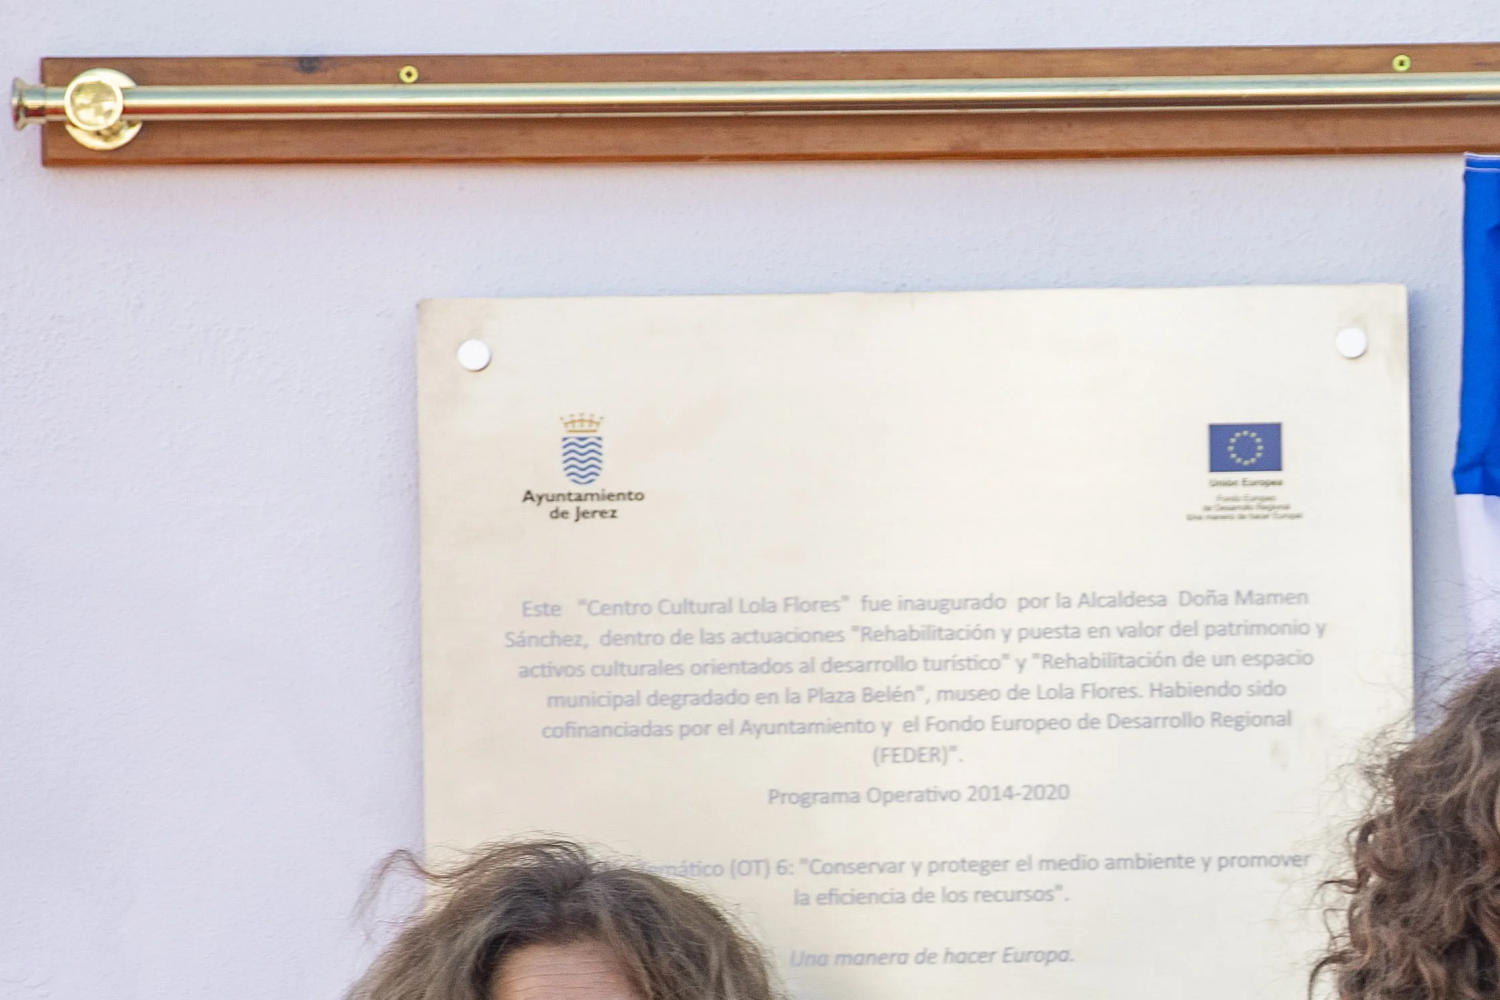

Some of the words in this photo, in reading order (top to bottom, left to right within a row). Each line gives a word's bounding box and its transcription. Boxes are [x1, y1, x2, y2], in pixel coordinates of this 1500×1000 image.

[522, 489, 646, 506] Ayuntamiento
[549, 507, 570, 519] de
[574, 506, 618, 522] Jerez
[521, 600, 562, 618] Este
[577, 598, 653, 617] "Centro
[657, 596, 734, 616] Cultural
[738, 596, 778, 615] Lola
[782, 594, 850, 614] Flores"
[860, 594, 893, 613] fue
[897, 592, 1008, 616] inaugurado
[1017, 596, 1051, 614] por
[1055, 591, 1073, 610] la
[1076, 590, 1169, 609] Alcaldesa
[1178, 588, 1230, 608] Doña
[1234, 588, 1309, 607] Mamen
[504, 629, 589, 650] Sánchez,
[599, 629, 666, 647] dentro
[669, 627, 696, 646] de
[699, 627, 726, 646] las
[730, 626, 846, 645] actuaciones
[850, 623, 997, 643] "Rehabilitación
[1000, 627, 1013, 645] y
[1016, 623, 1082, 644] puesta
[1086, 625, 1112, 640] en
[1115, 620, 1165, 639] valor
[1168, 619, 1199, 638] del
[1203, 618, 1312, 641] patrimonio
[1315, 622, 1328, 639] y
[518, 660, 586, 679] activos
[590, 658, 686, 678] culturales
[689, 656, 795, 676] orientados
[798, 655, 816, 675] al
[819, 654, 919, 674] desarrollo
[922, 652, 1011, 672] turístico"
[1014, 657, 1028, 675] y
[1031, 649, 1177, 670] "Rehabilitación
[1181, 649, 1207, 668] de
[1210, 653, 1237, 668] un
[1240, 648, 1315, 671] espacio
[546, 689, 642, 712] municipal
[645, 687, 751, 711] degradado
[754, 691, 780, 706] en
[784, 686, 802, 705] la
[806, 686, 857, 705] Plaza
[861, 684, 931, 706] Belén",
[936, 688, 1002, 703] museo
[1005, 682, 1032, 702] de
[1036, 682, 1076, 701] Lola
[1080, 681, 1144, 700] Flores.
[1148, 679, 1243, 699] Habiendo
[1246, 678, 1288, 698] sido
[541, 719, 674, 739] cofinanciadas
[678, 723, 713, 741] por
[716, 717, 735, 737] el
[738, 717, 877, 740] Ayuntamiento
[880, 720, 893, 738] y
[902, 714, 920, 734] el
[924, 714, 986, 733] Fondo
[990, 714, 1073, 735] Europeo
[1076, 712, 1102, 731] de
[1106, 710, 1206, 730] Desarrollo
[1209, 708, 1293, 733] Regional
[872, 744, 965, 768] (FEDER)".
[767, 788, 862, 810] Programa
[865, 785, 962, 808] Operativo
[966, 783, 1071, 803] 2014-2020
[729, 857, 772, 881] (OT)
[775, 858, 795, 877] 6:
[798, 857, 907, 876] "Conservar
[910, 860, 923, 878] y
[927, 857, 1013, 878] proteger
[1016, 854, 1033, 873] el
[1037, 852, 1100, 872] medio
[1104, 852, 1197, 871] ambiente
[1200, 855, 1213, 873] y
[1216, 853, 1312, 873] promover
[793, 888, 811, 907] la
[815, 887, 907, 907] eficiencia
[910, 886, 937, 905] de
[940, 885, 969, 904] los
[972, 883, 1070, 904] recursos".
[789, 950, 830, 968] Una
[834, 951, 910, 967] manera
[913, 947, 939, 966] de
[942, 946, 998, 965] hacer
[1001, 946, 1077, 967] Europa.
